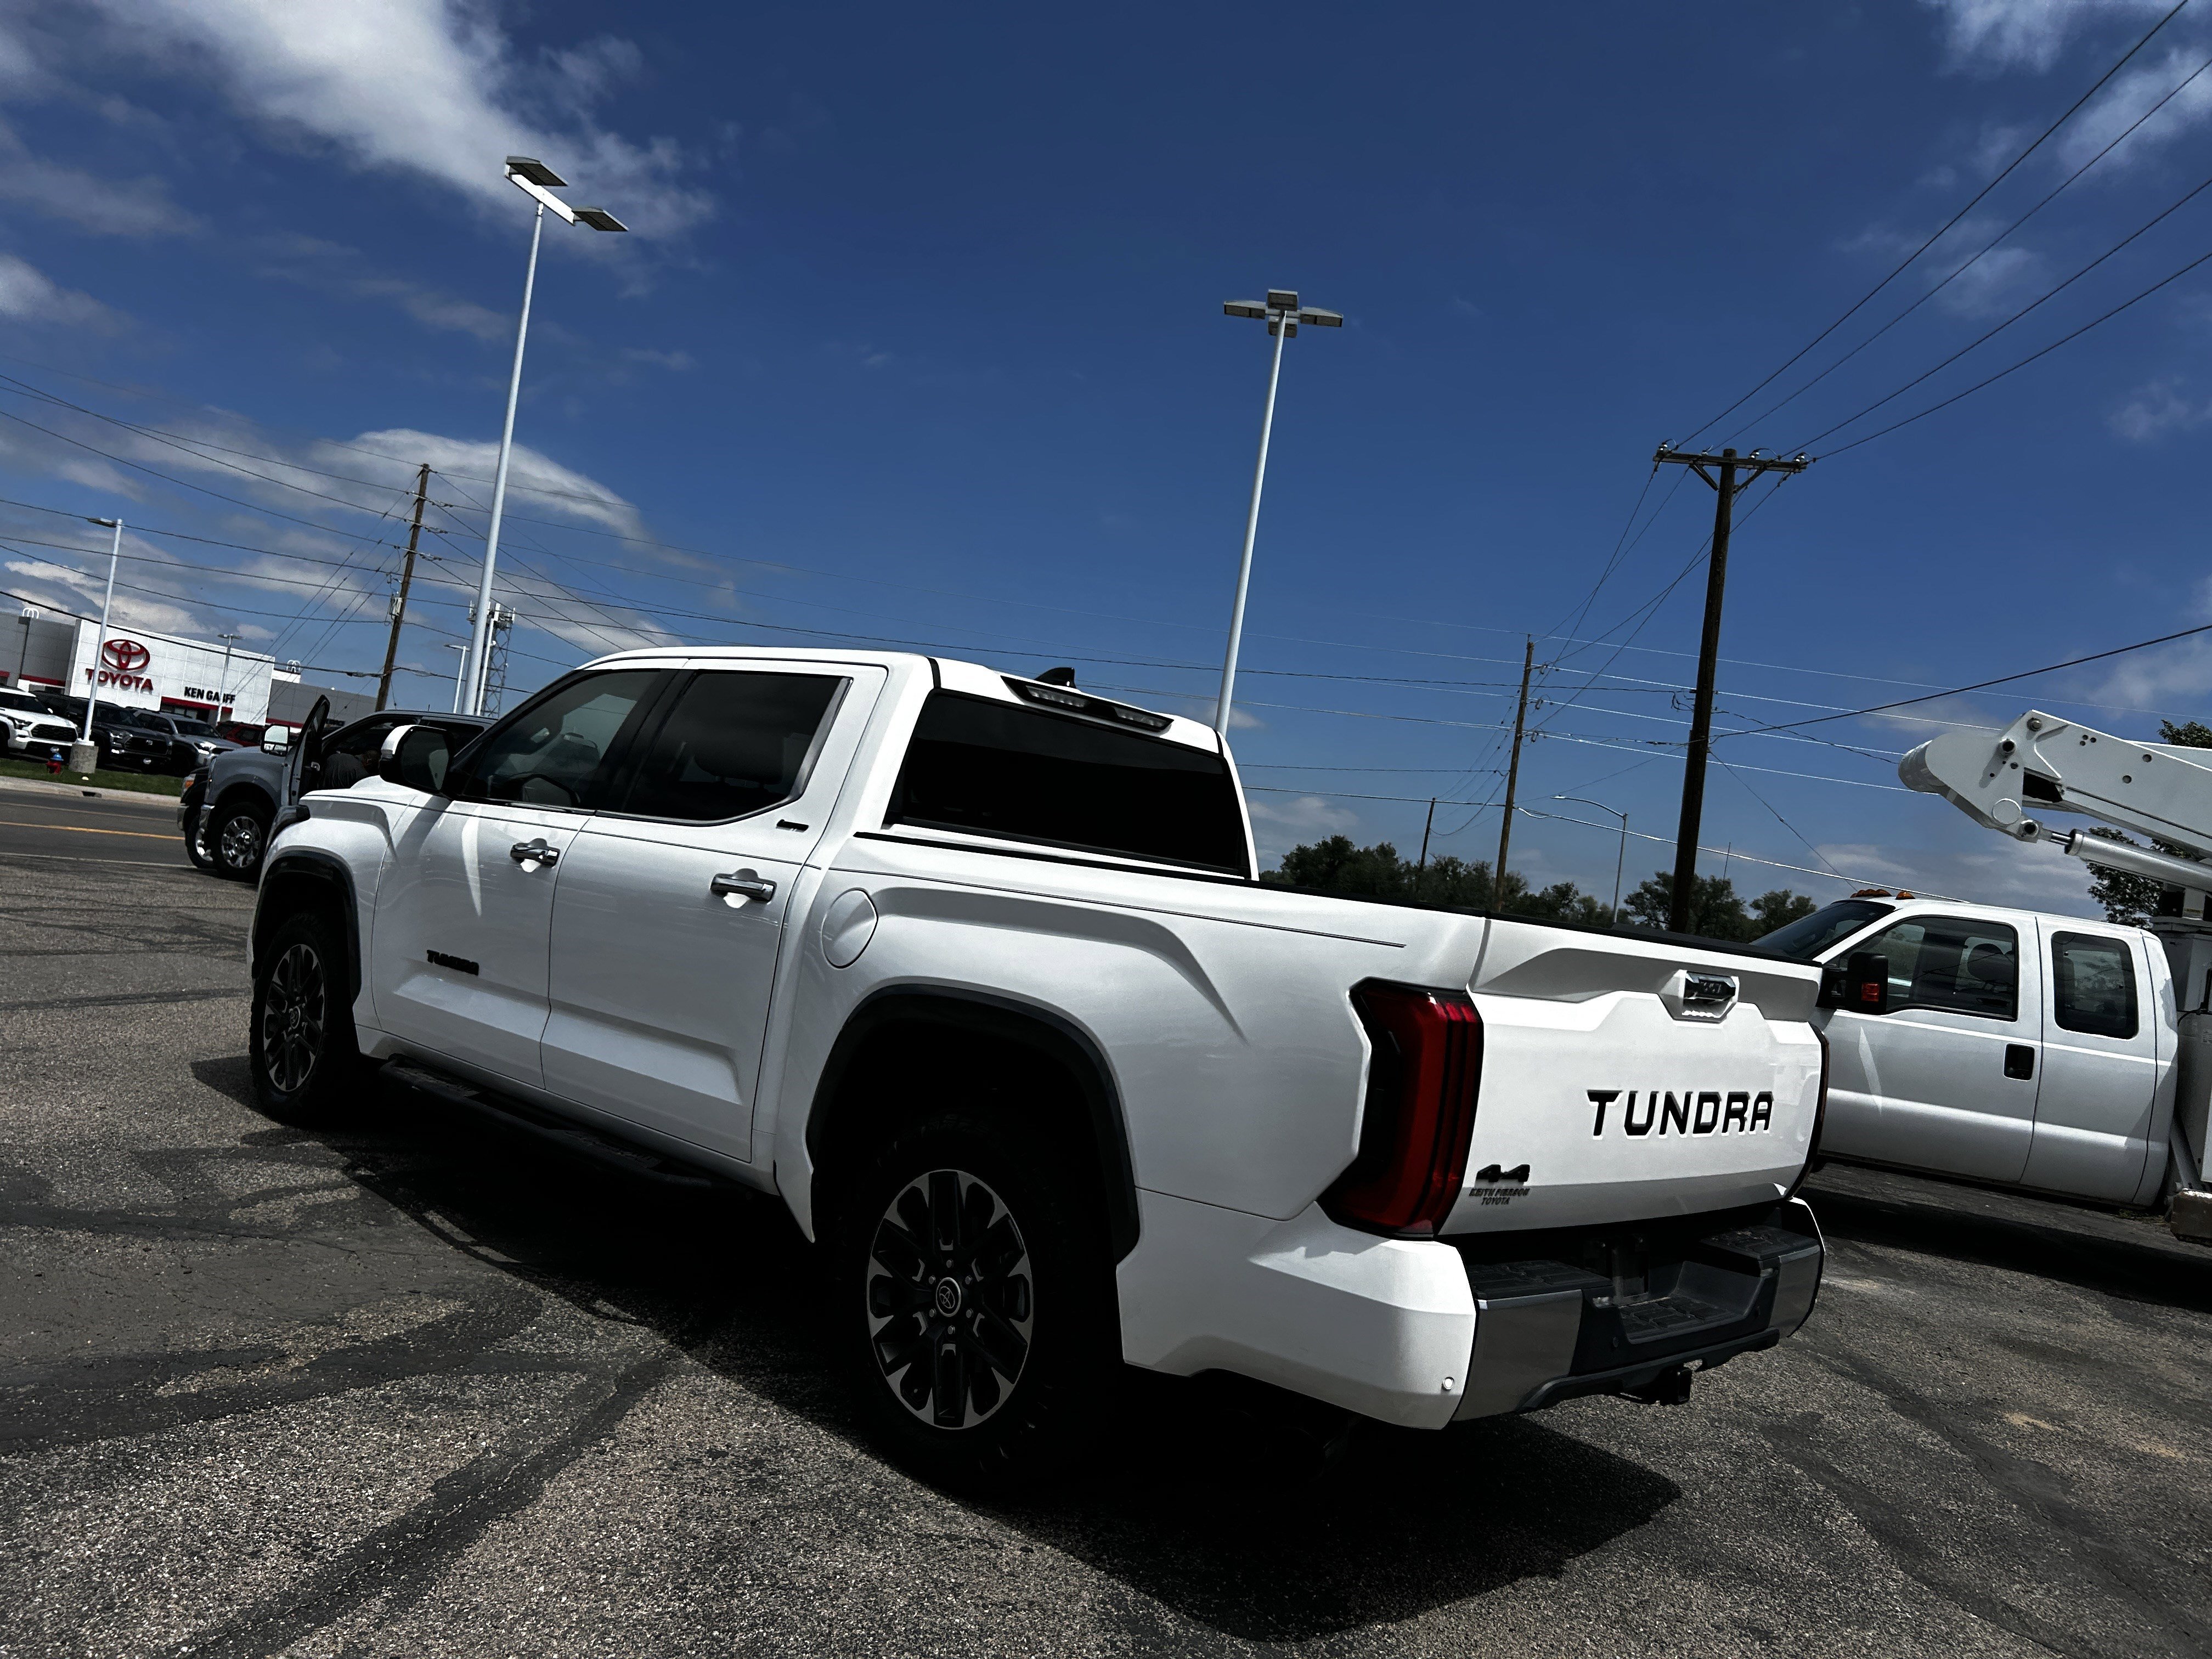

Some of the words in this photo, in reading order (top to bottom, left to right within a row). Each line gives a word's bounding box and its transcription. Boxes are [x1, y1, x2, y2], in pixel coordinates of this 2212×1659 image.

[85, 668, 154, 691] TOYOTA
[184, 686, 205, 699] KEN
[1587, 1090, 1774, 1137] TUNDRA
[1469, 1188, 1496, 1197] KEITH
[1481, 1197, 1510, 1206] TOYOTA
